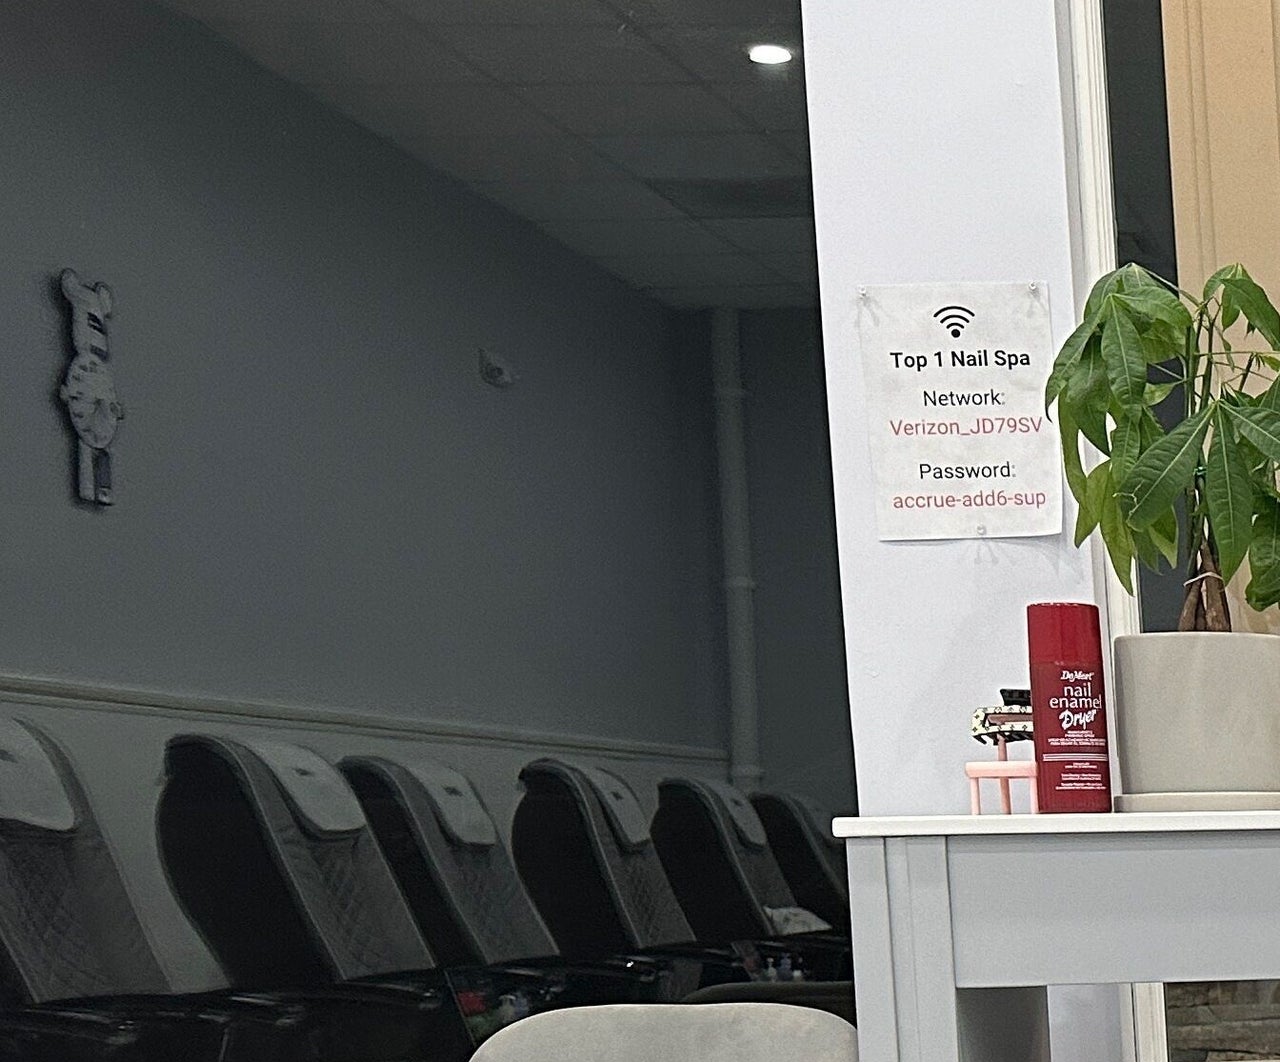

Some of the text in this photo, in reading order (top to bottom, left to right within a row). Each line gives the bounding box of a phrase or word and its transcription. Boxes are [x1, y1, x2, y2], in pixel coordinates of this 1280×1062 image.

[889, 349, 1031, 372] Top 1 Nail Spa
[923, 388, 1006, 407] Network:
[889, 416, 1043, 437] Verizon_JD79SV
[919, 461, 1017, 479] Password:
[892, 489, 1047, 510] accrue-add6-sup
[1063, 682, 1092, 696] nail
[1049, 693, 1102, 709] enamel
[1058, 709, 1097, 730] Dryer
